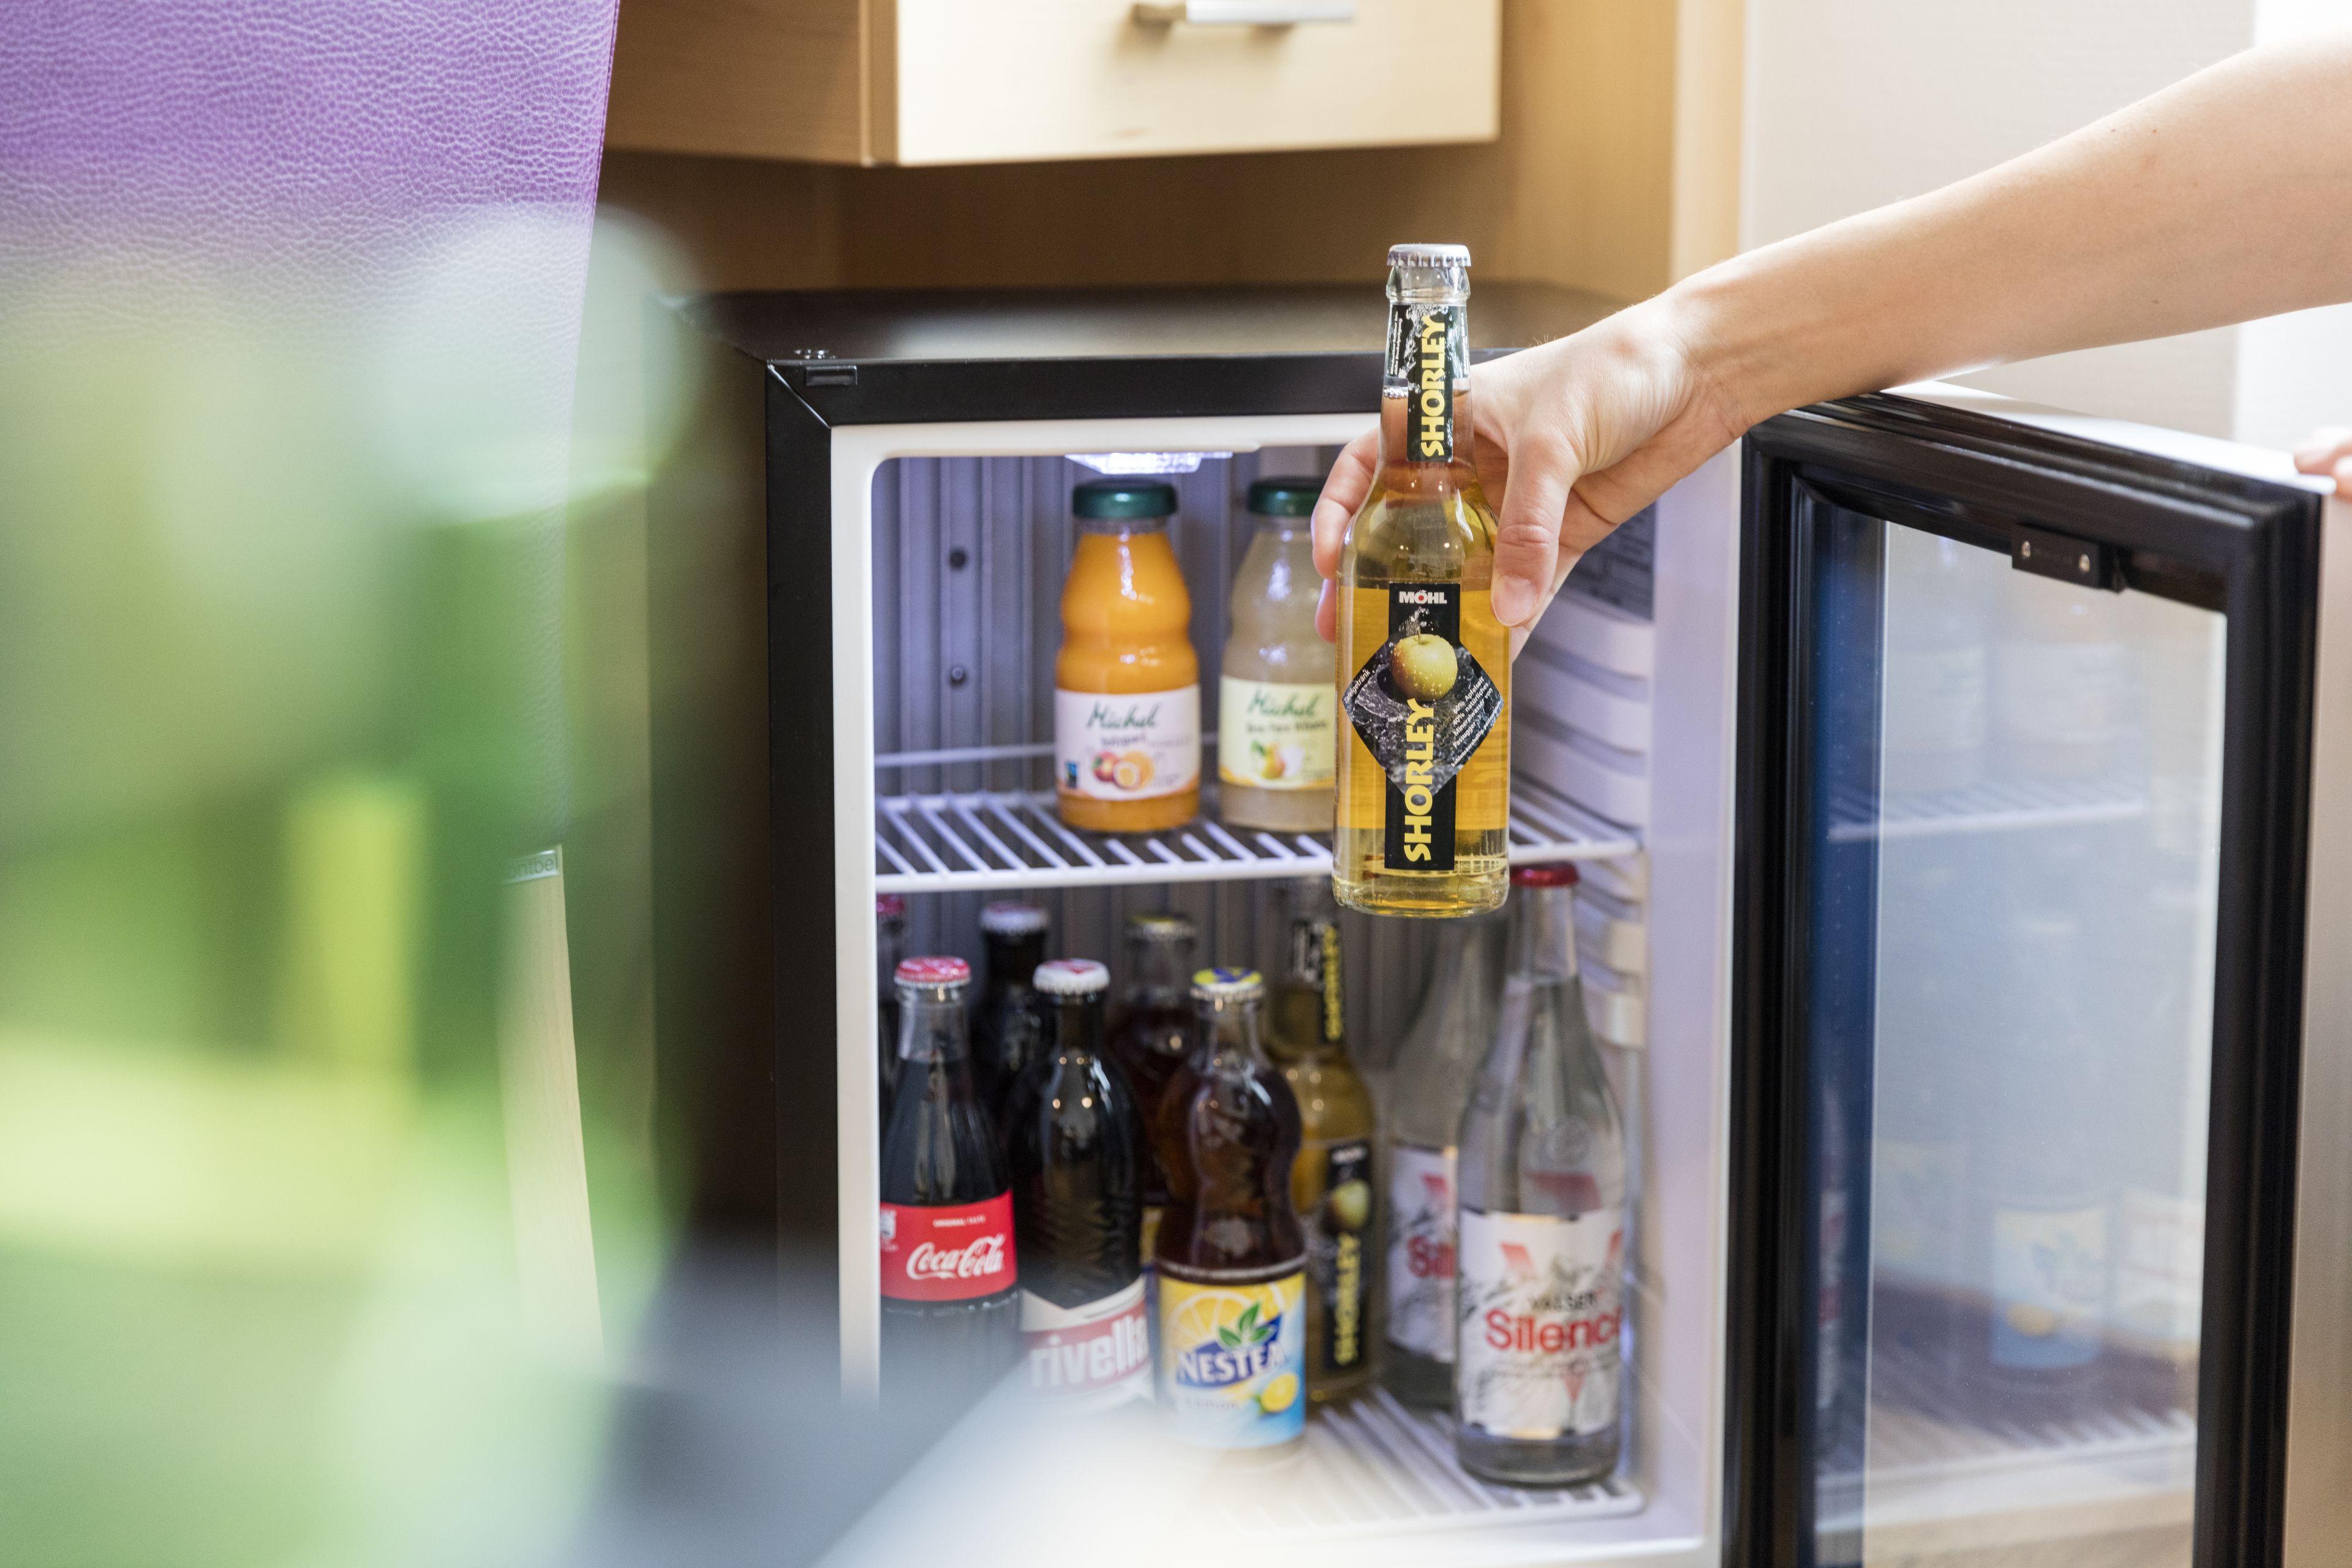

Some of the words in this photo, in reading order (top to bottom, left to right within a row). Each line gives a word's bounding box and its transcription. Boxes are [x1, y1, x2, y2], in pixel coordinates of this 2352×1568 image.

[1420, 315, 1445, 457] SHORLEY
[1399, 589, 1447, 605] MÖHL
[1453, 712, 1465, 726] 40%
[1465, 682, 1489, 712] natürliches
[1453, 697, 1485, 736] Mineralwasser
[1484, 687, 1493, 699] von
[1452, 720, 1477, 749] Passugger
[1404, 698, 1435, 862] SHORLEY
[1177, 1342, 1286, 1383] NESTEA
